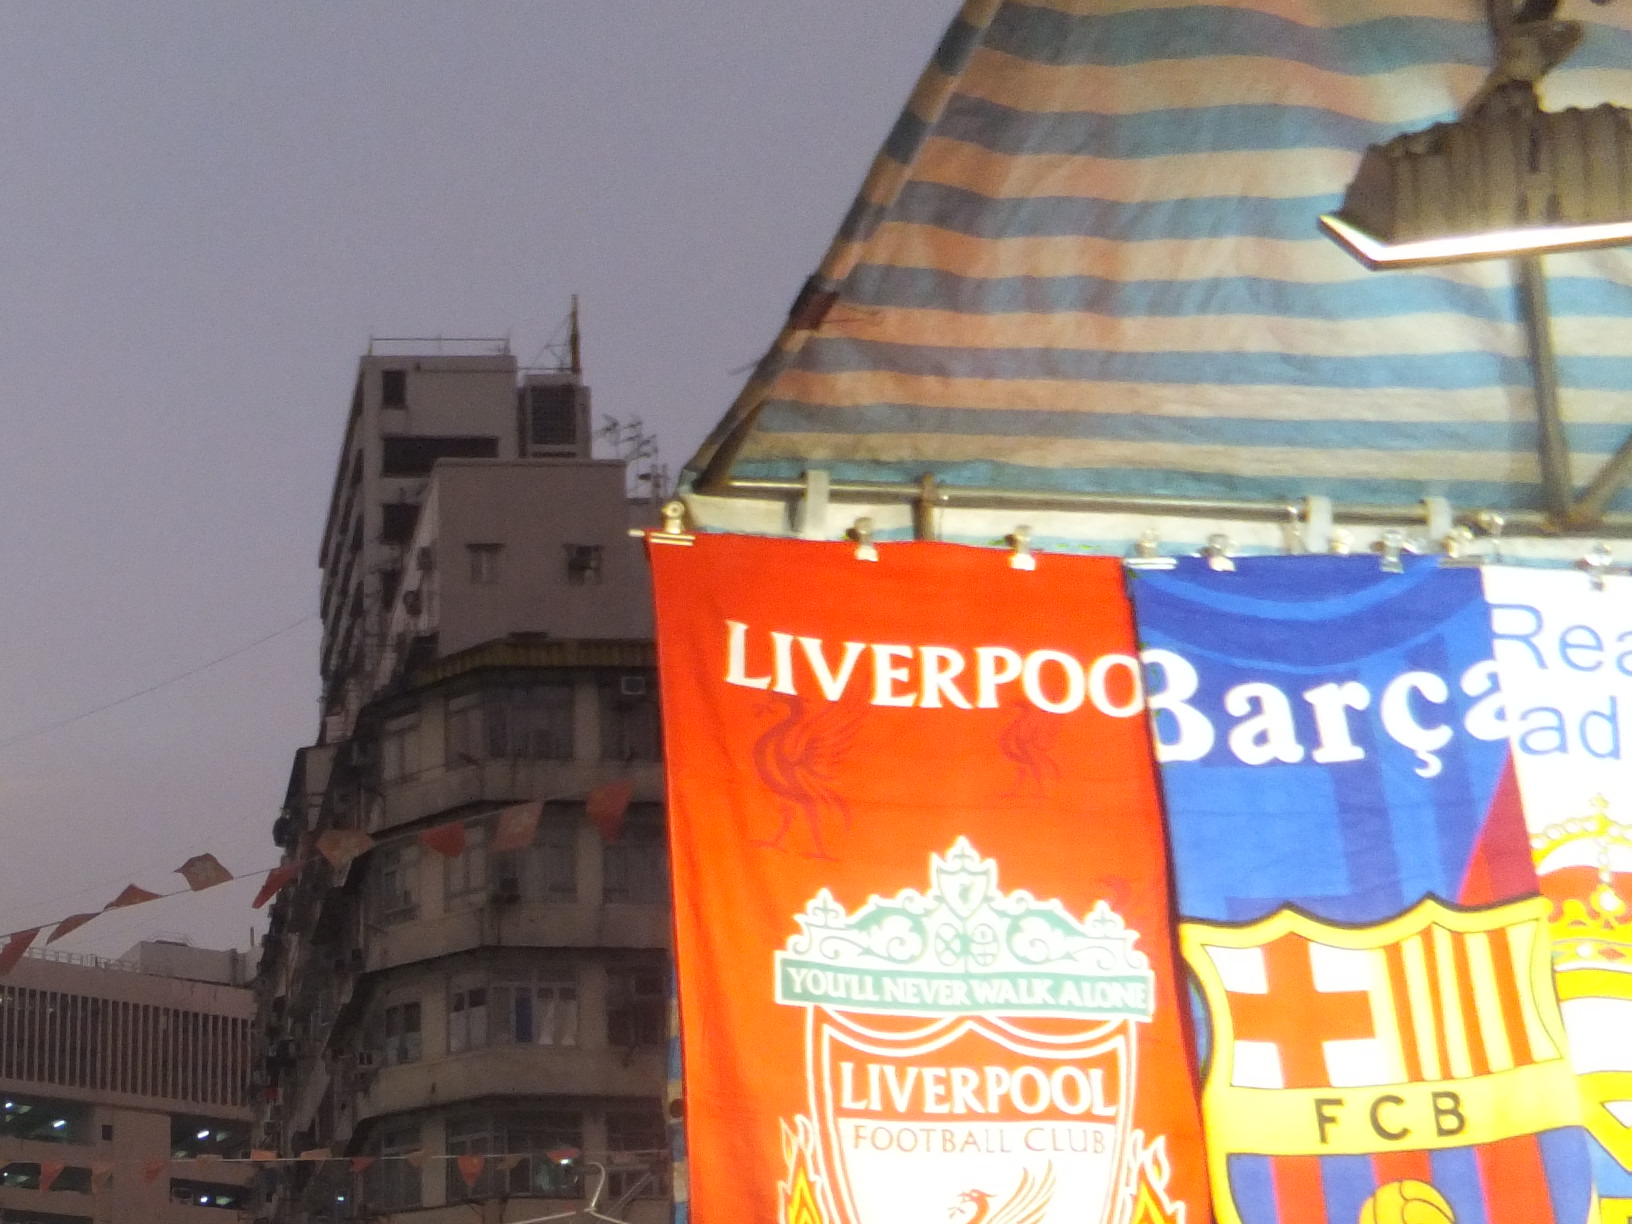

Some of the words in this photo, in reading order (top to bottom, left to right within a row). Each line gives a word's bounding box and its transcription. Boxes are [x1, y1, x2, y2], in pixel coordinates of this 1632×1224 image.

[1141, 647, 1510, 779] Barça
[787, 967, 878, 1003] YOU'LL
[882, 975, 967, 1007] NEVER
[969, 977, 1056, 1007] WALK
[1059, 980, 1147, 1010] ALONE
[839, 1061, 1118, 1118] LIVERPOOL
[852, 1124, 1012, 1155] FOOTBALL
[1023, 1126, 1107, 1155] CLUB
